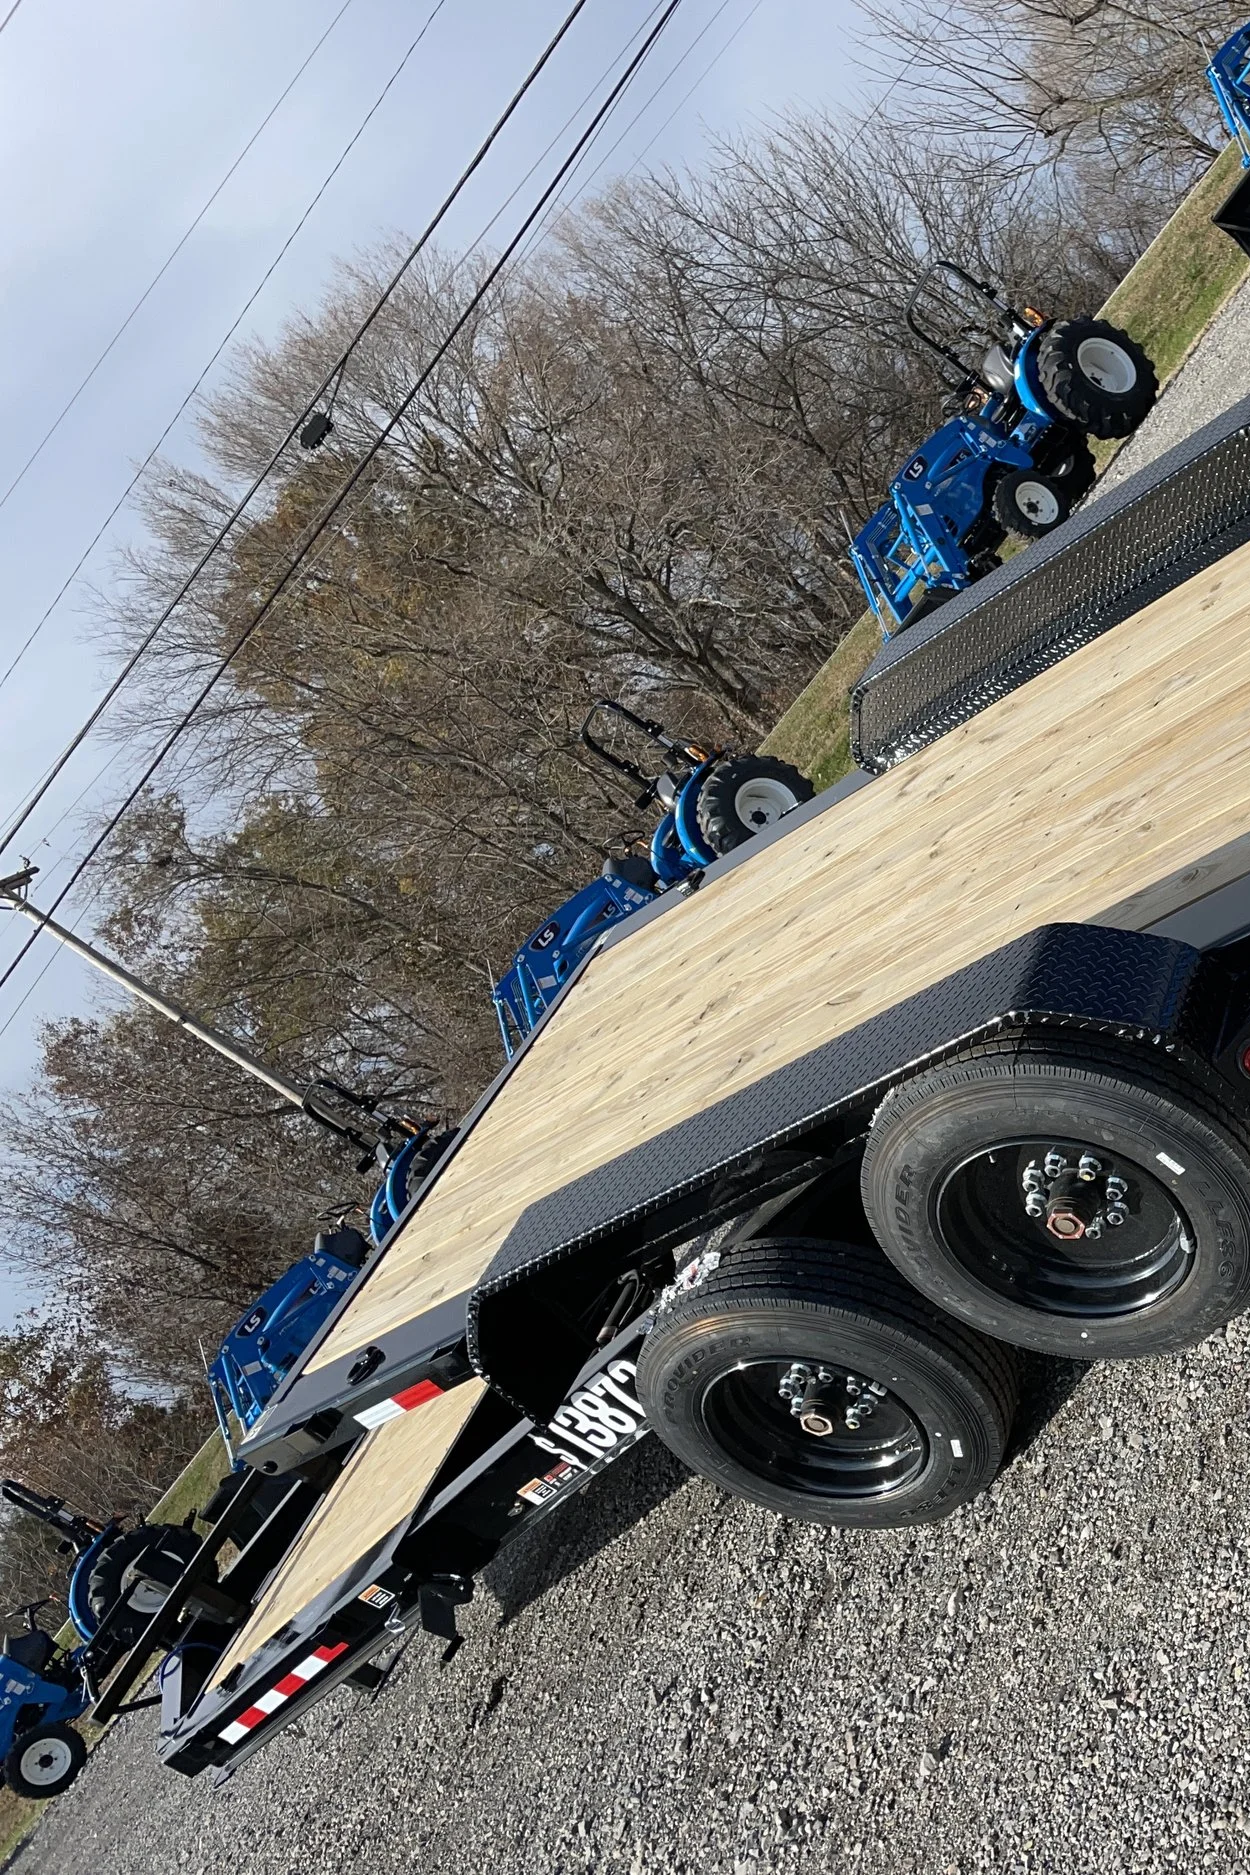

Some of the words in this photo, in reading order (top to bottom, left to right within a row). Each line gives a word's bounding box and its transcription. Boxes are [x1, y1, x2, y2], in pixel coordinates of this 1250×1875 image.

[909, 462, 924, 478] LS
[602, 904, 616, 919] LS
[537, 929, 555, 947] LS
[895, 1164, 966, 1300] OVIDER
[244, 1314, 261, 1333] LS
